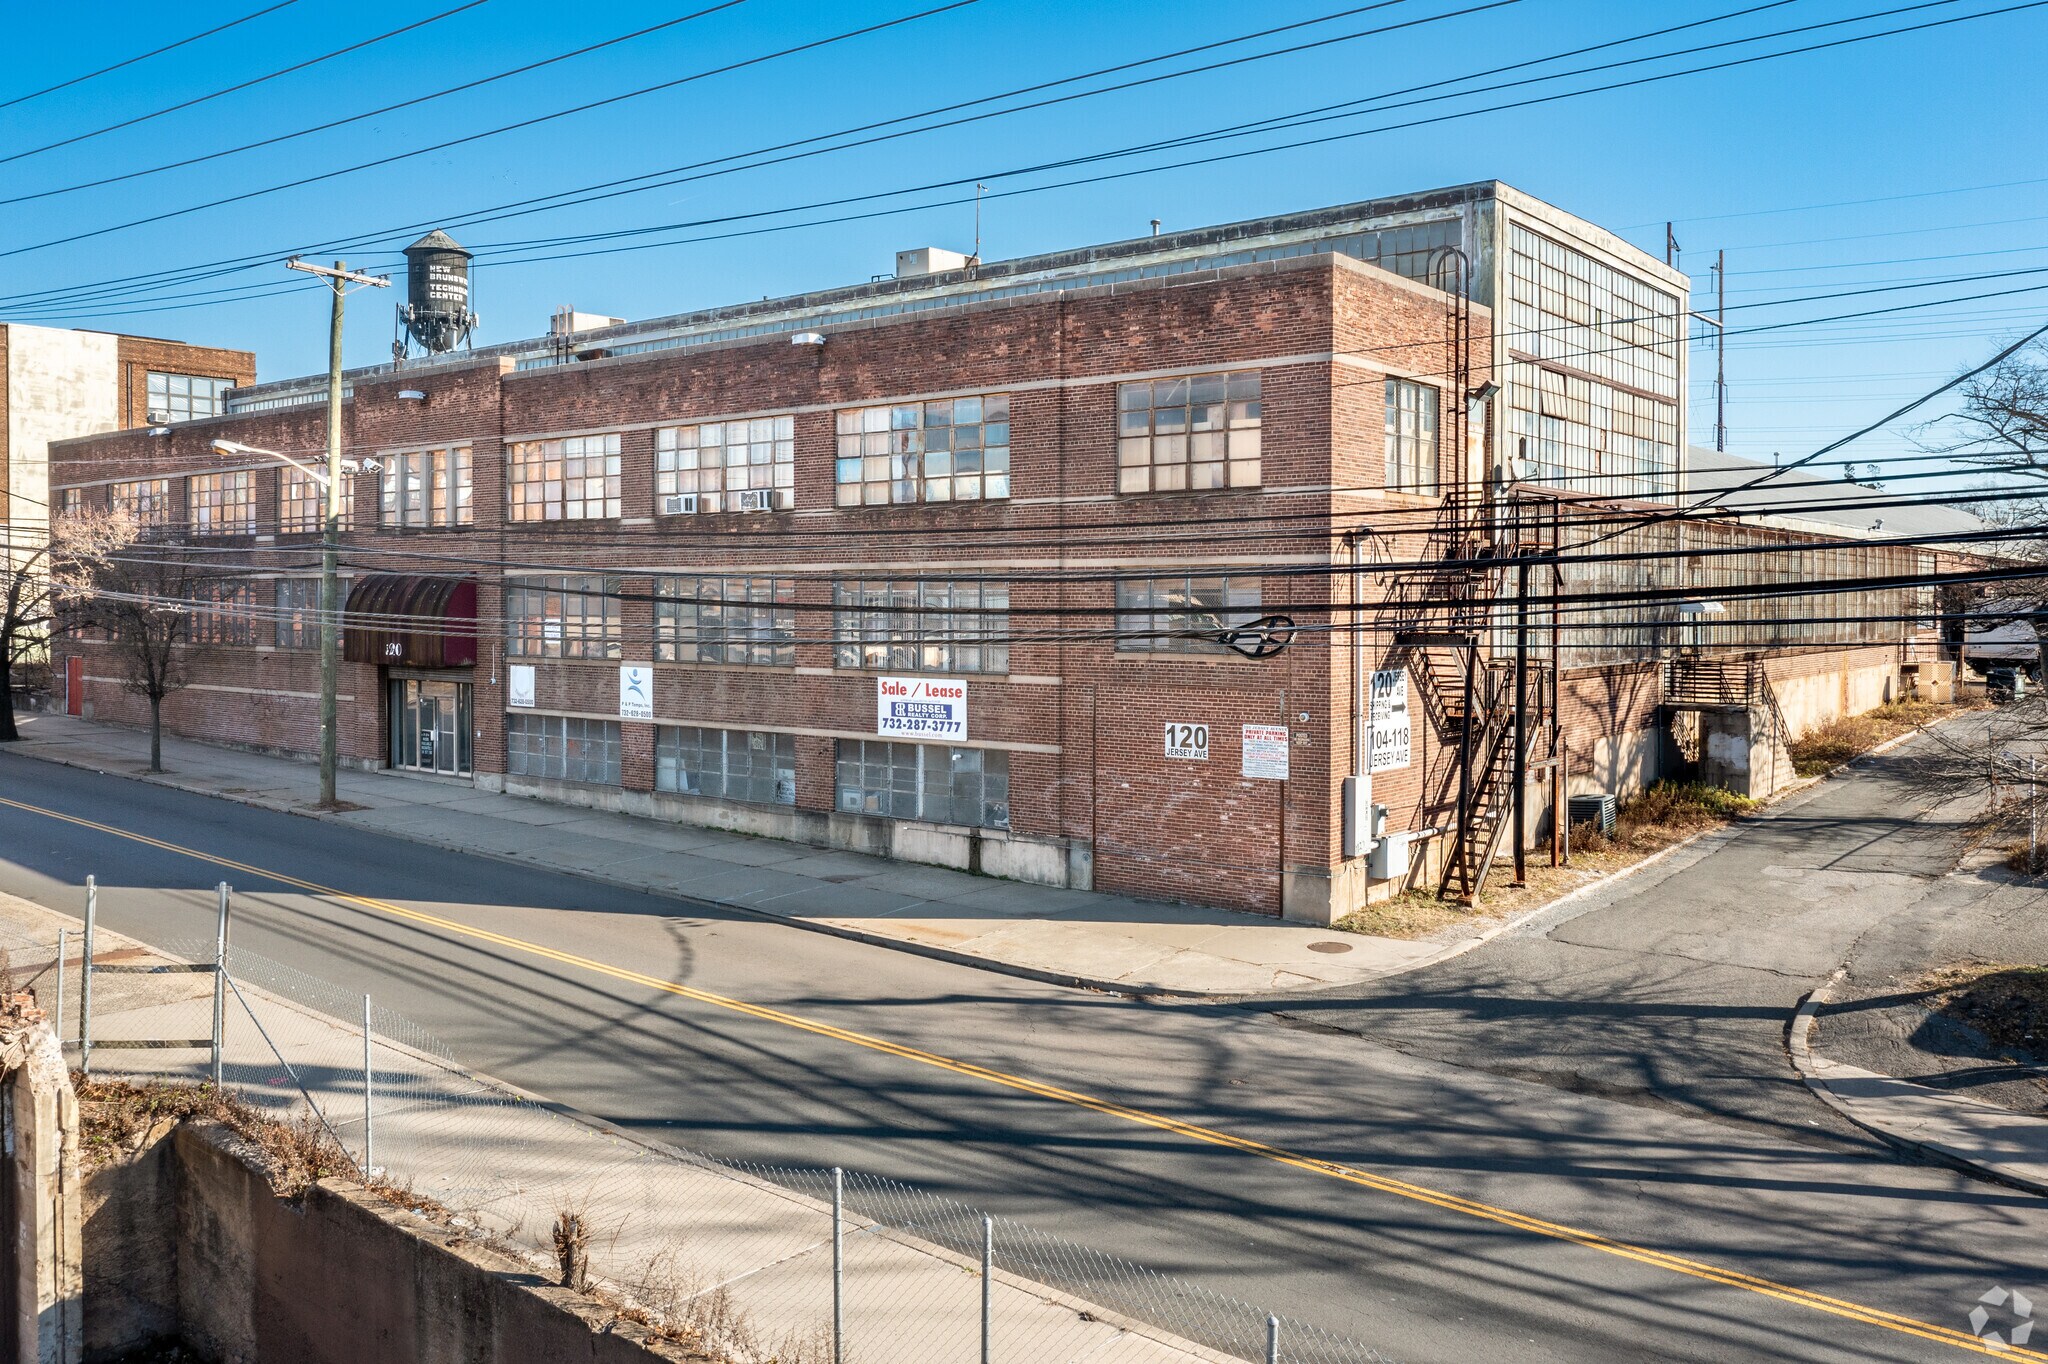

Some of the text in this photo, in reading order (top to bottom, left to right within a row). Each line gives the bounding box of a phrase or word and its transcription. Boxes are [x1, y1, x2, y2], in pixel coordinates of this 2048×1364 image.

[430, 265, 450, 273] NEW
[430, 291, 463, 302] CENTER
[385, 642, 402, 656] 120
[881, 681, 907, 695] Sale
[925, 683, 963, 698] Lease
[1370, 671, 1392, 698] 120
[621, 709, 651, 718] 732-628-0500
[907, 703, 947, 714] BUSSEL
[882, 717, 962, 733] 732-287-3777
[901, 731, 943, 739] www.bussel.com
[1166, 724, 1208, 750] 120
[1370, 727, 1409, 750] 104-118
[1167, 748, 1207, 758] JERSEY AVE
[1370, 749, 1408, 768] JERSEY AVE
